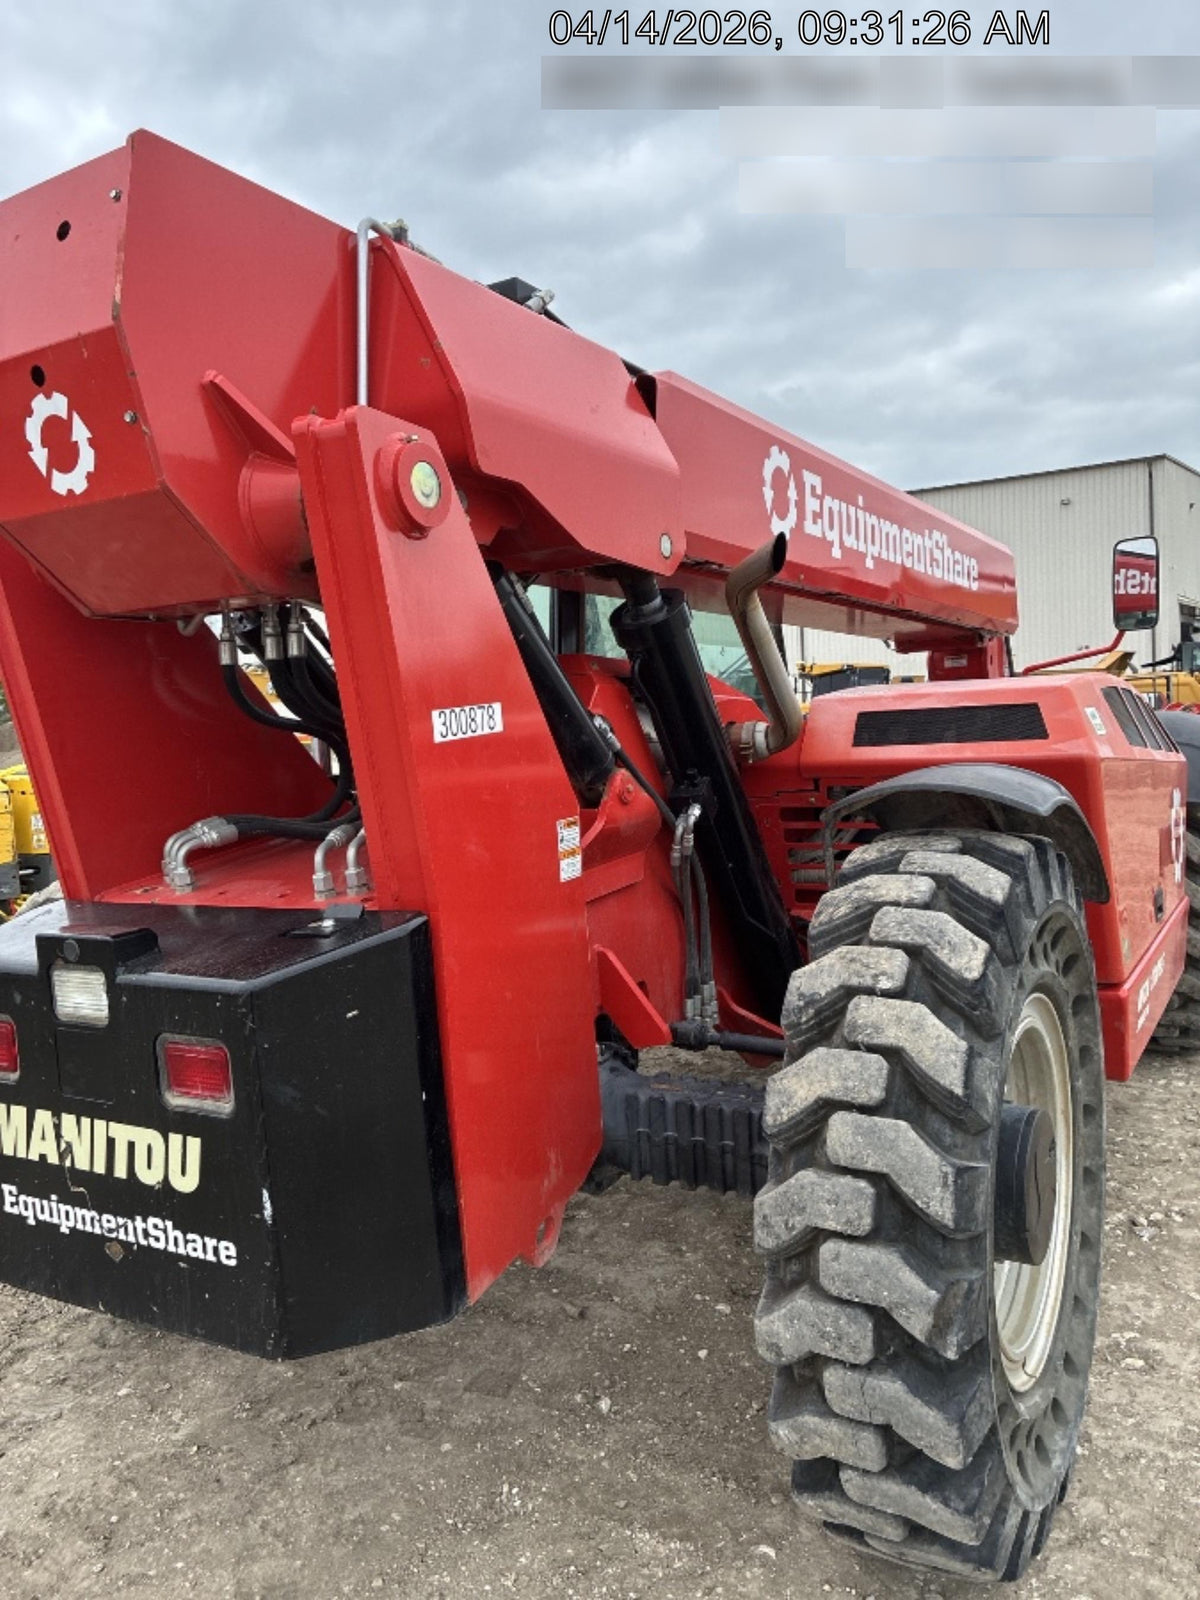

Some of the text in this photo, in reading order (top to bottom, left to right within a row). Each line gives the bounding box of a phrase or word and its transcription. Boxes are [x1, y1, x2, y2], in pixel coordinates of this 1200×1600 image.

[802, 469, 979, 591] EquipmentShare
[438, 704, 496, 738] 300878
[0, 1103, 202, 1194] MANITOU
[1, 1183, 238, 1267] EquipmentShare
